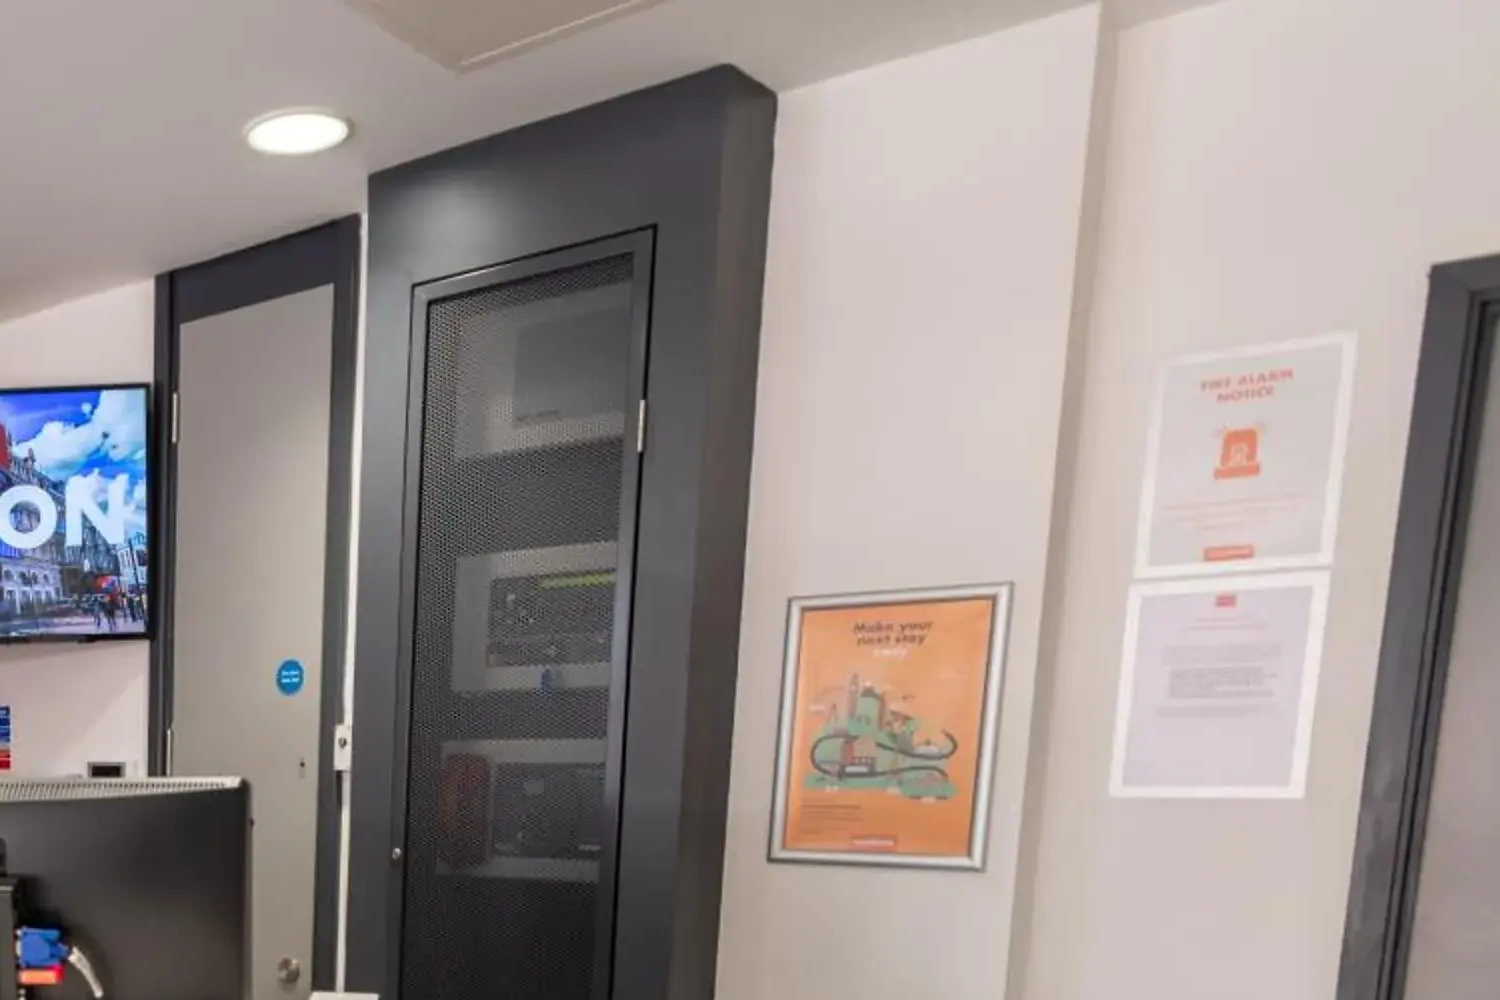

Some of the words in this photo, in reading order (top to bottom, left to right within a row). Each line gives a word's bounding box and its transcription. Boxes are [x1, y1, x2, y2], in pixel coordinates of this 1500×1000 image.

[853, 621, 893, 634] Make
[899, 622, 933, 636] your
[894, 634, 926, 648] stay
